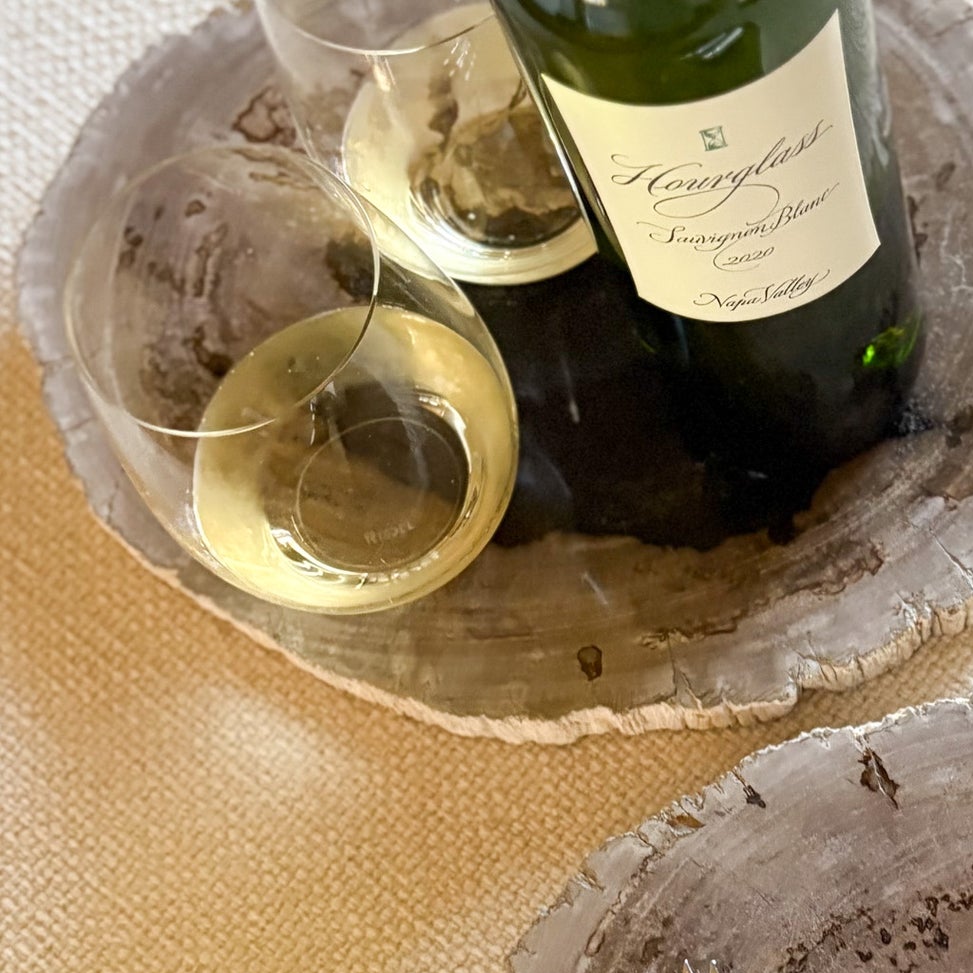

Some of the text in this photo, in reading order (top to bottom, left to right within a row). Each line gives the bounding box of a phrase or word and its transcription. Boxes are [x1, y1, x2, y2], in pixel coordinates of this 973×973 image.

[611, 120, 833, 218] Hourglass
[638, 183, 840, 252] Sauvignon Blanc
[721, 246, 776, 267] 2020
[693, 269, 831, 311] Napa Valley
